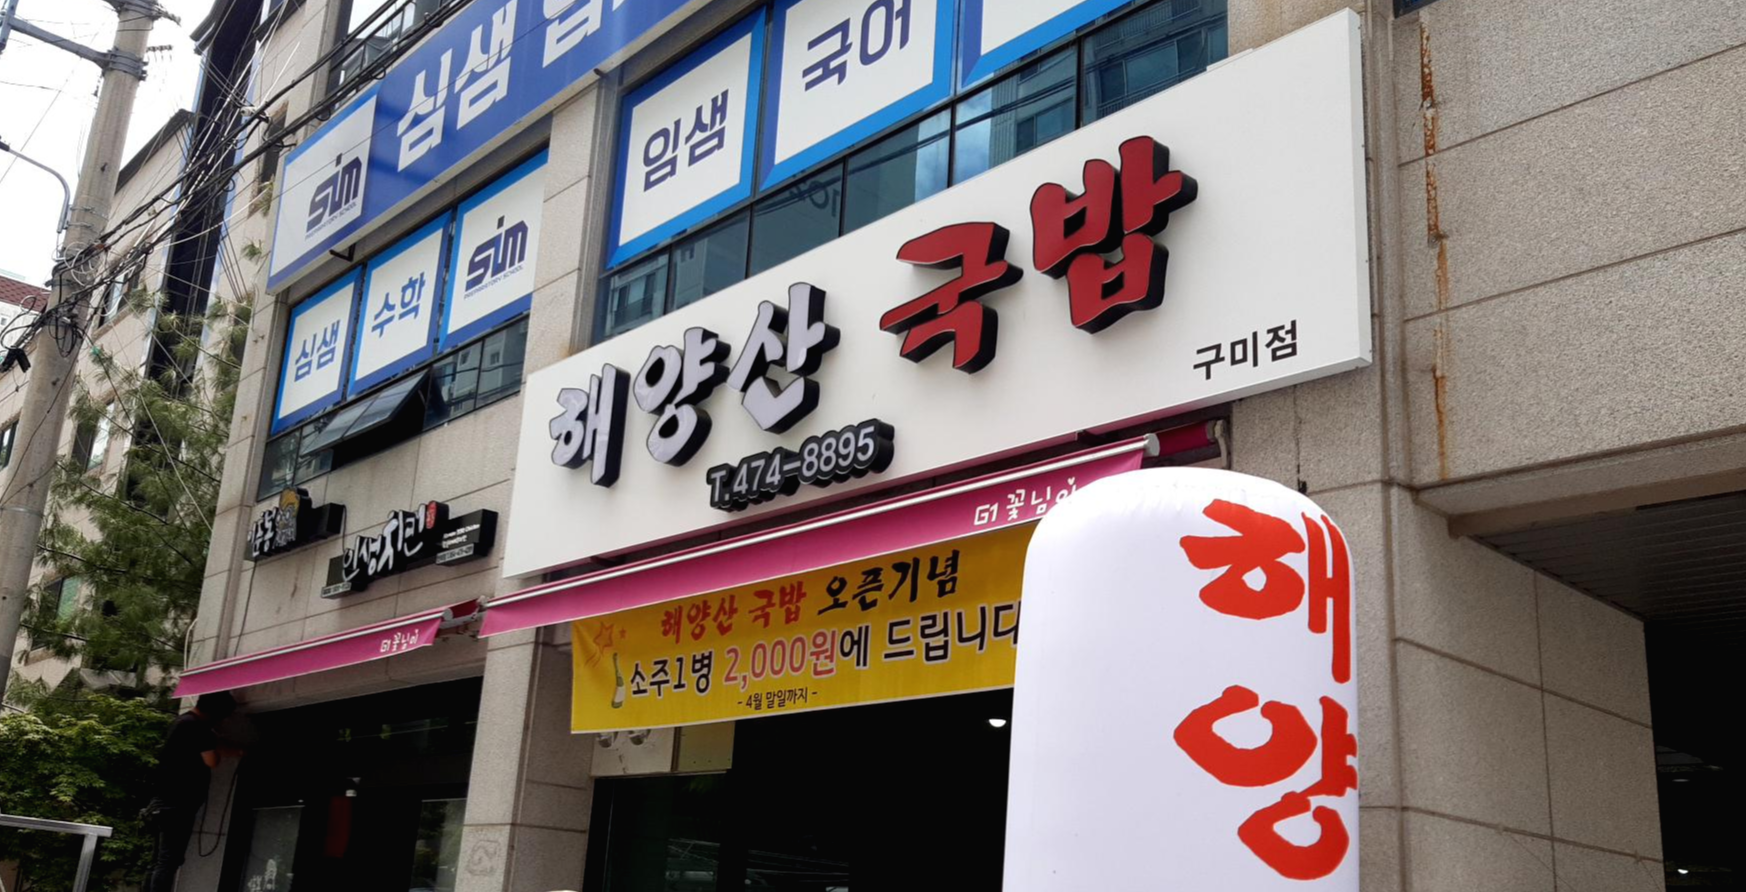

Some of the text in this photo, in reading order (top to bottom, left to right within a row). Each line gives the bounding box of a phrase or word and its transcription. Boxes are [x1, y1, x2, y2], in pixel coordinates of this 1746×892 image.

[397, 0, 517, 172] 심샘
[802, 0, 911, 92] 국어
[643, 89, 729, 192] 임샘
[294, 319, 341, 382] 심샘
[371, 272, 425, 338] 수학
[549, 135, 1194, 488] 해양산 국밥
[1193, 320, 1298, 380] 구미점
[709, 422, 883, 505] T.474-8895
[974, 502, 998, 526] G1
[660, 549, 960, 645] 해양산 국밥 오픈기념
[630, 600, 1021, 697] 소주1병 2,000원에 드립니다
[1173, 498, 1358, 881] 해양
[745, 686, 808, 711] 4월 말일까지
